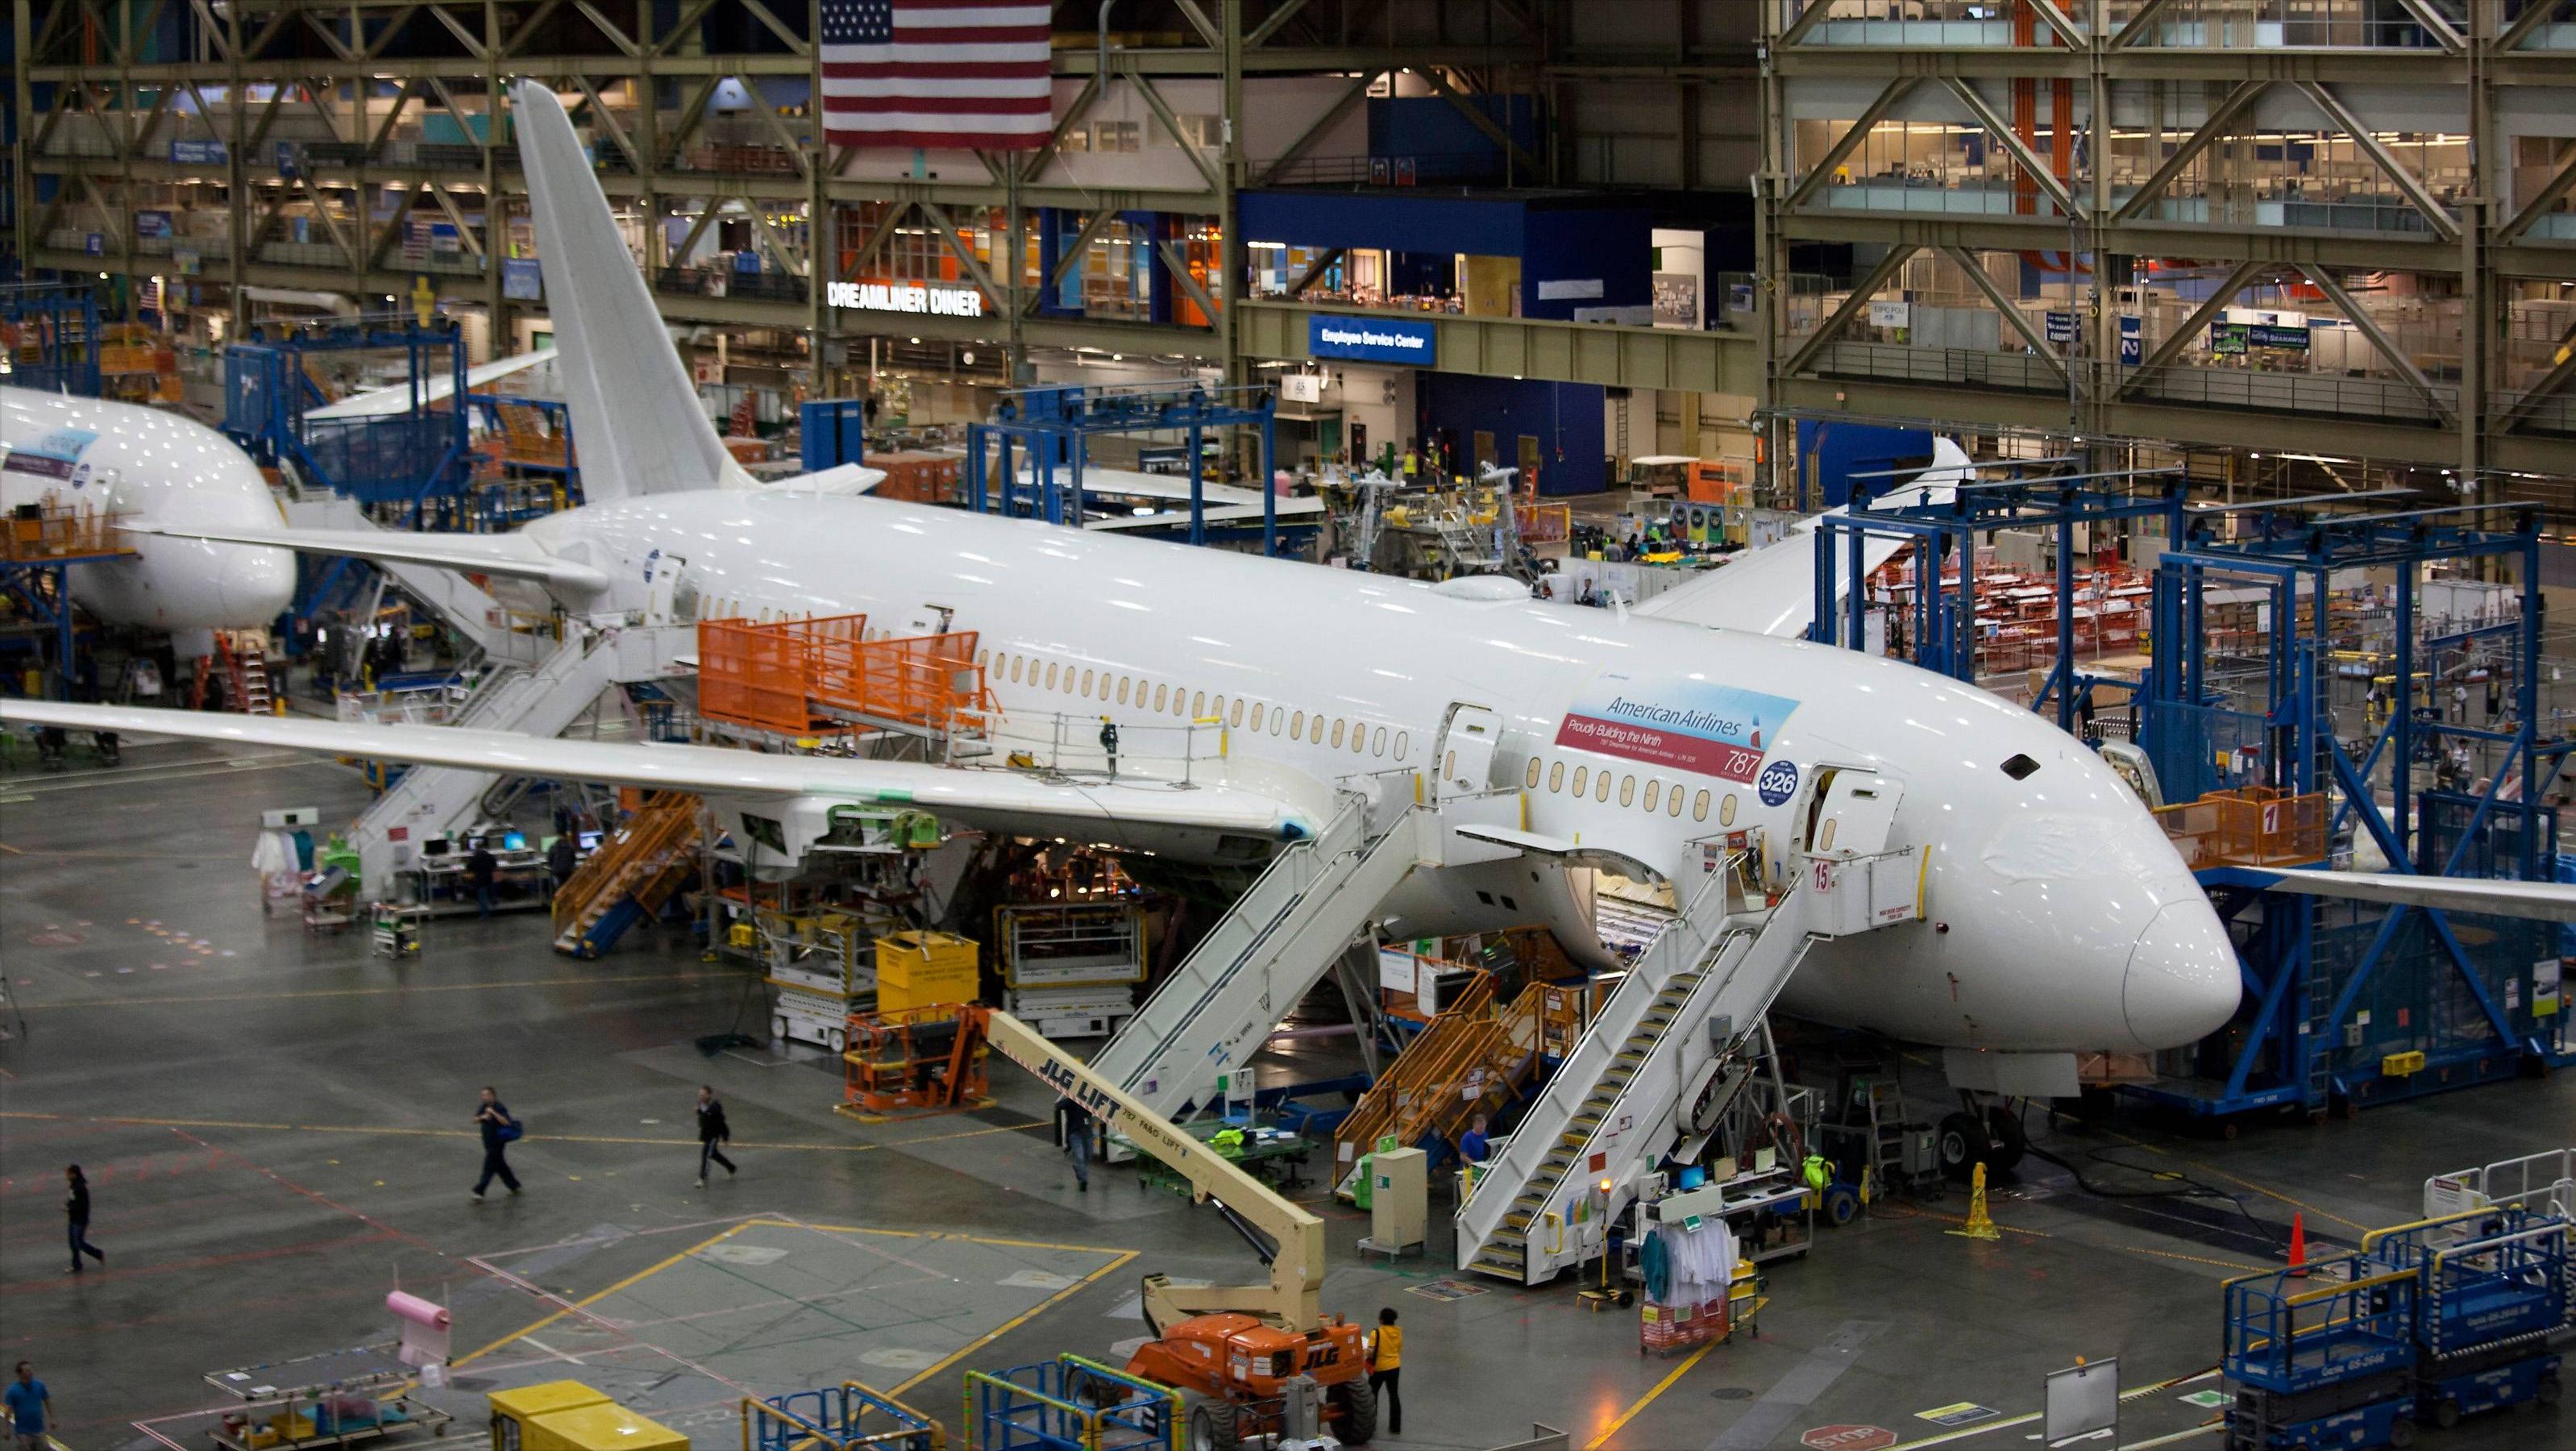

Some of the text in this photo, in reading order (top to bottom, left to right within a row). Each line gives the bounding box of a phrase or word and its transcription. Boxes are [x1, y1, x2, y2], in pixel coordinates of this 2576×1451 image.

[827, 281, 981, 317] DREAMLINER DINER
[1321, 328, 1424, 349] Employee Service Center
[2121, 330, 2139, 355] 12
[1606, 696, 1741, 736] American Airlines
[1567, 719, 1661, 746] Proudly Building the Ninth
[1724, 750, 1761, 775] 787
[1760, 771, 1797, 794] 326
[2265, 806, 2276, 831] 1
[1815, 863, 1828, 889] 15
[1038, 1058, 1121, 1119] JLG LIFT
[1161, 1134, 1181, 1151] LIFT
[1301, 1347, 1340, 1370] JLG
[1810, 1428, 1875, 1448] STOP
